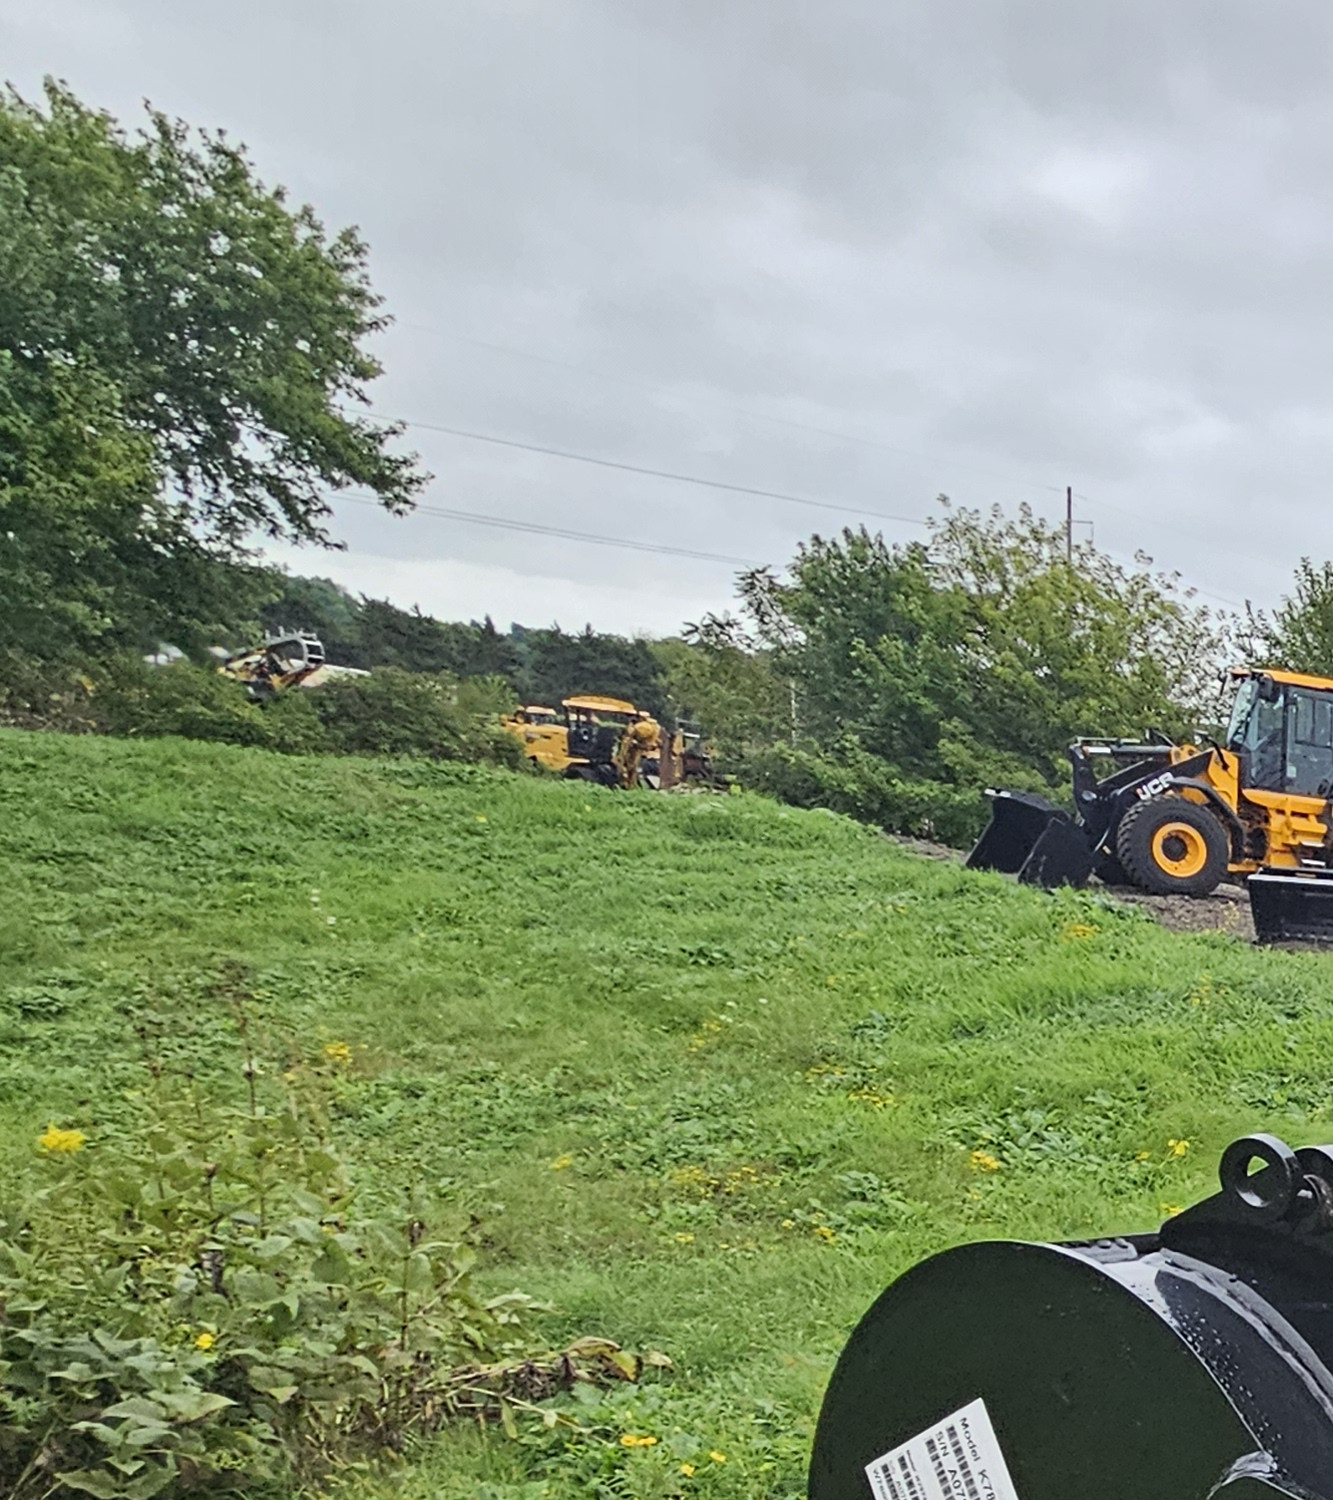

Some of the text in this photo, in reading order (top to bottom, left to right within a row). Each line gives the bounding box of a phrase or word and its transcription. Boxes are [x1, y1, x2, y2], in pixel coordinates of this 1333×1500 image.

[1136, 772, 1175, 801] JCB
[934, 1430, 950, 1458] S/N
[957, 1416, 981, 1462] Model
